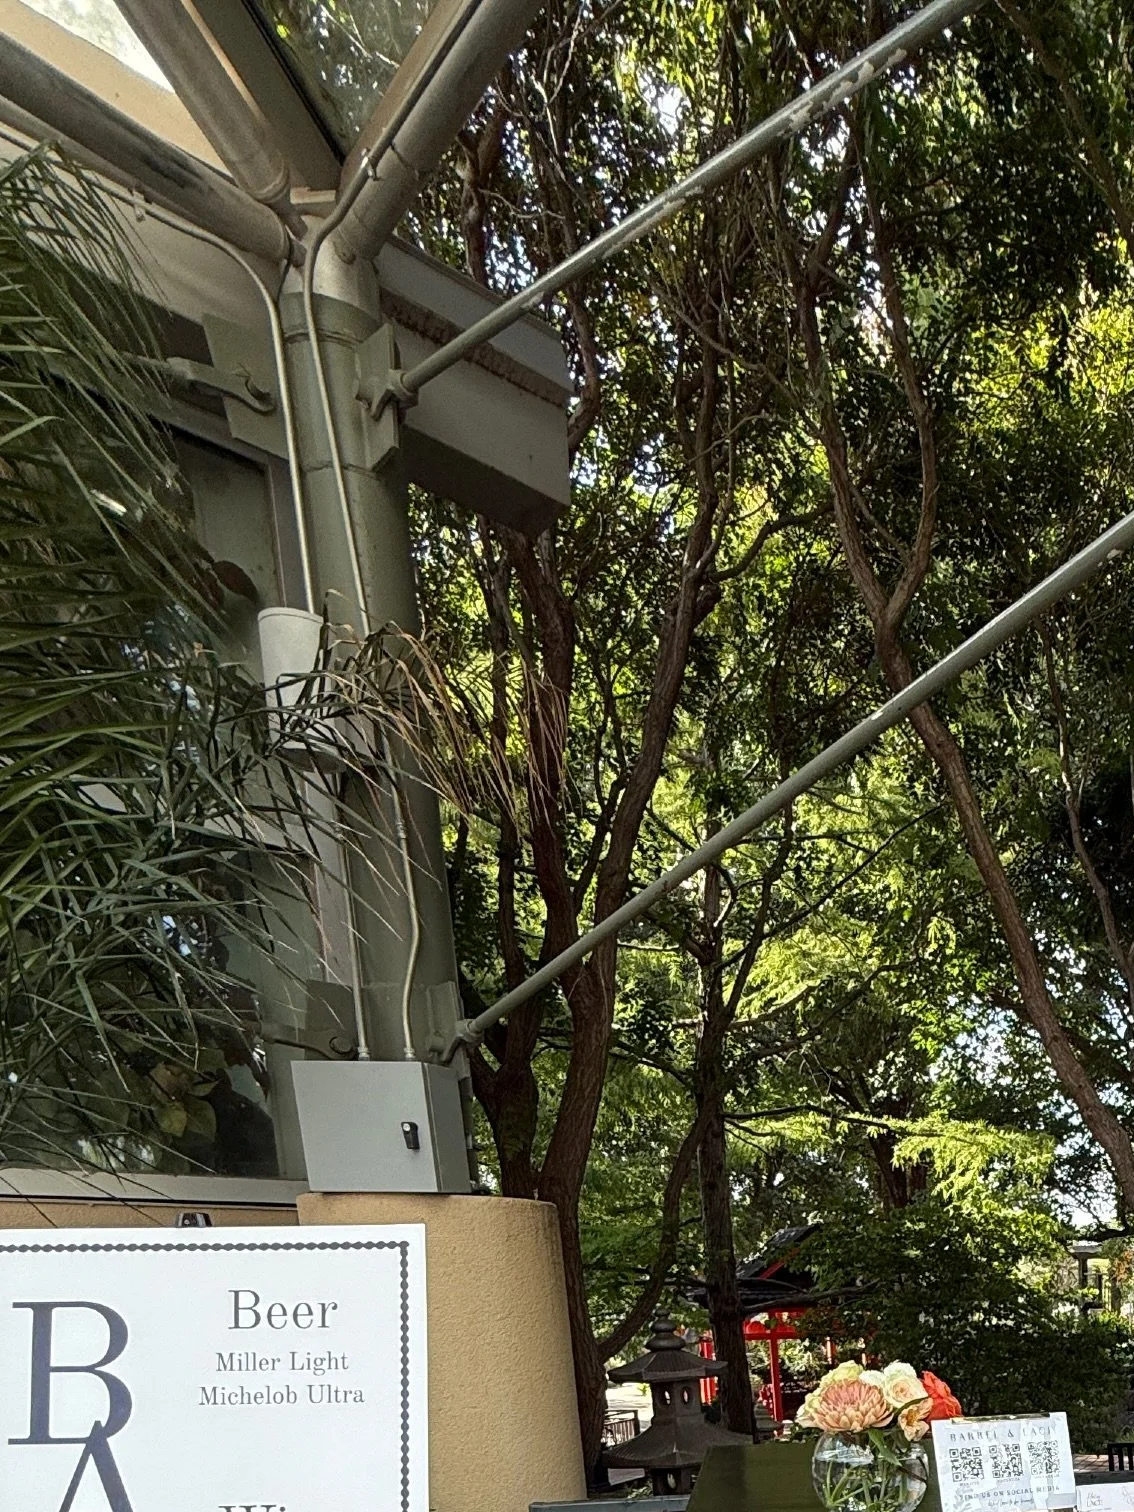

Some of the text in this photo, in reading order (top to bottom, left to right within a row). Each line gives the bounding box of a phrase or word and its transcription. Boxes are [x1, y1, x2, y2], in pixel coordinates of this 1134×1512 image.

[227, 1289, 338, 1330] Beer
[215, 1350, 349, 1376] Miller Light
[198, 1384, 365, 1406] Michelob Ultra
[1007, 1487, 1033, 1496] SOCIAL
